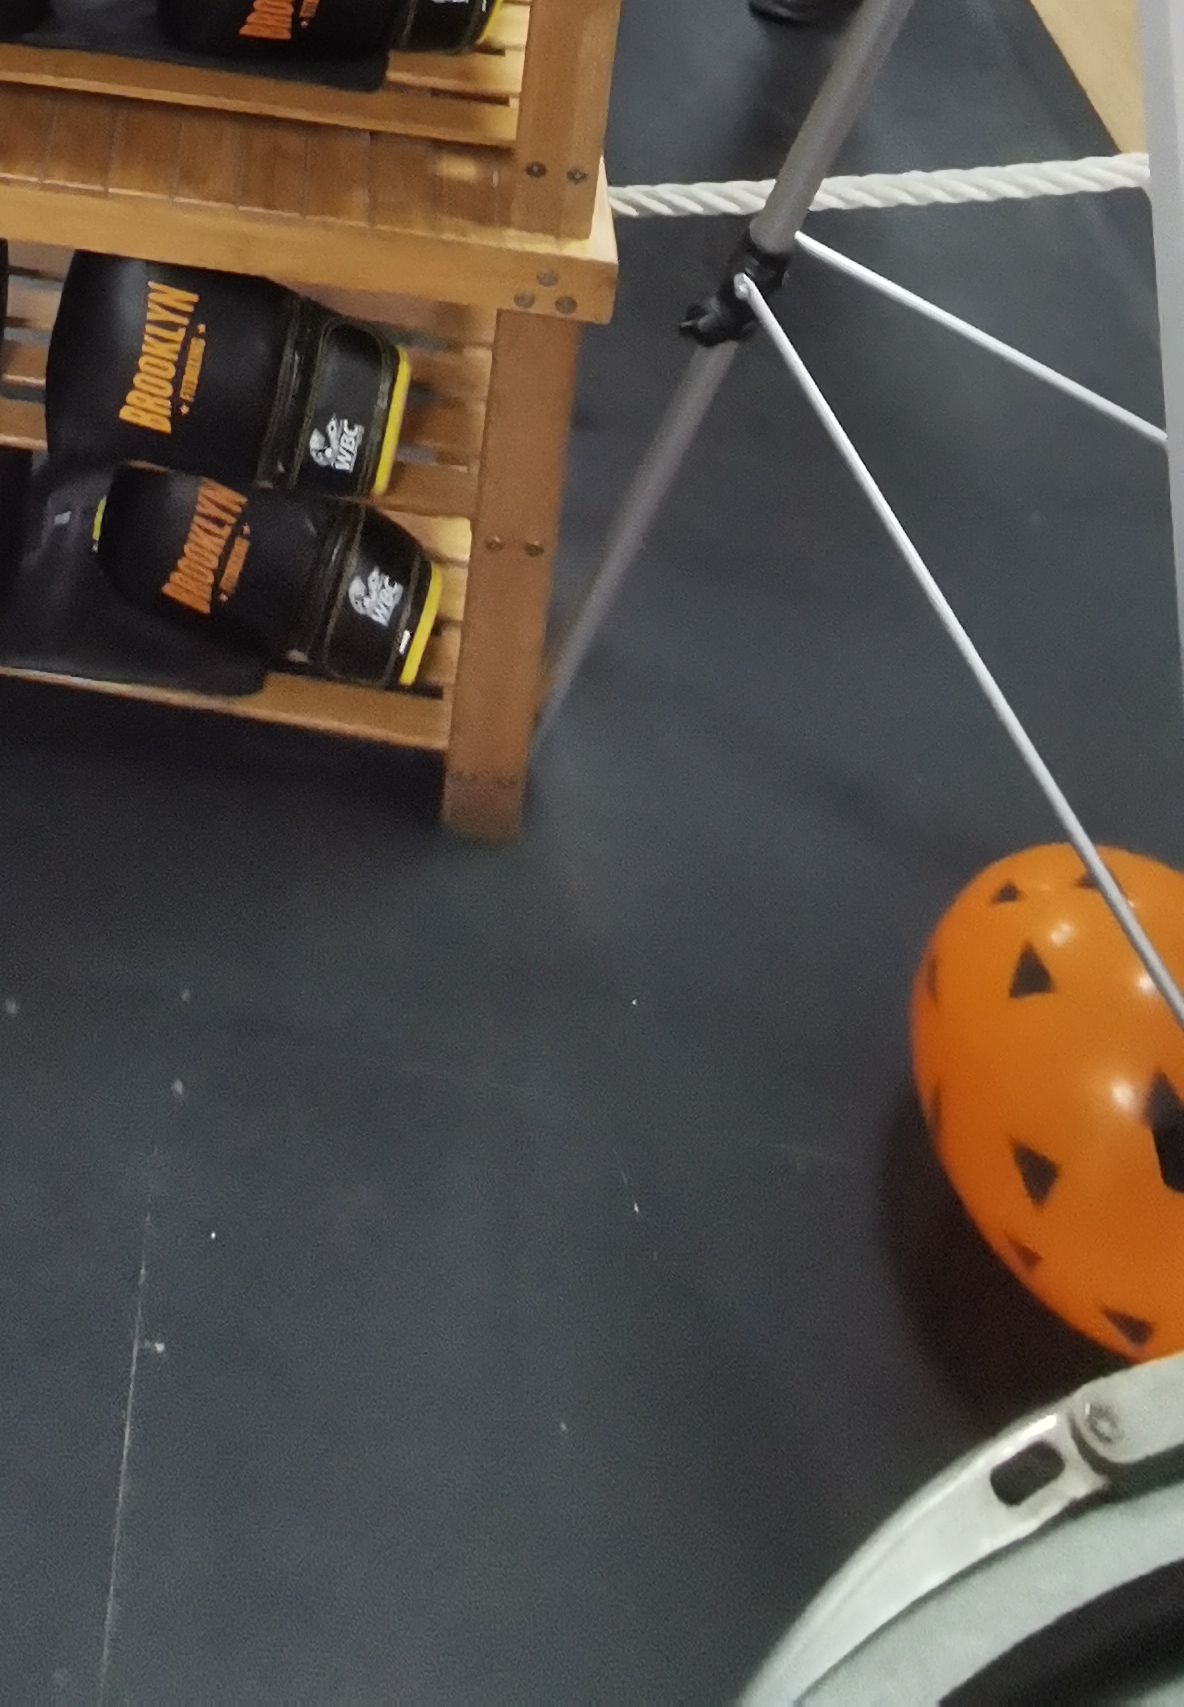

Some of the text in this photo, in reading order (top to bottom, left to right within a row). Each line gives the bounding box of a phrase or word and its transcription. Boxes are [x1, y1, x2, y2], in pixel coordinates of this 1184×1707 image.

[119, 281, 200, 434] BROOKLYN
[335, 419, 358, 471] WBC
[161, 476, 248, 615] BROOKLYN
